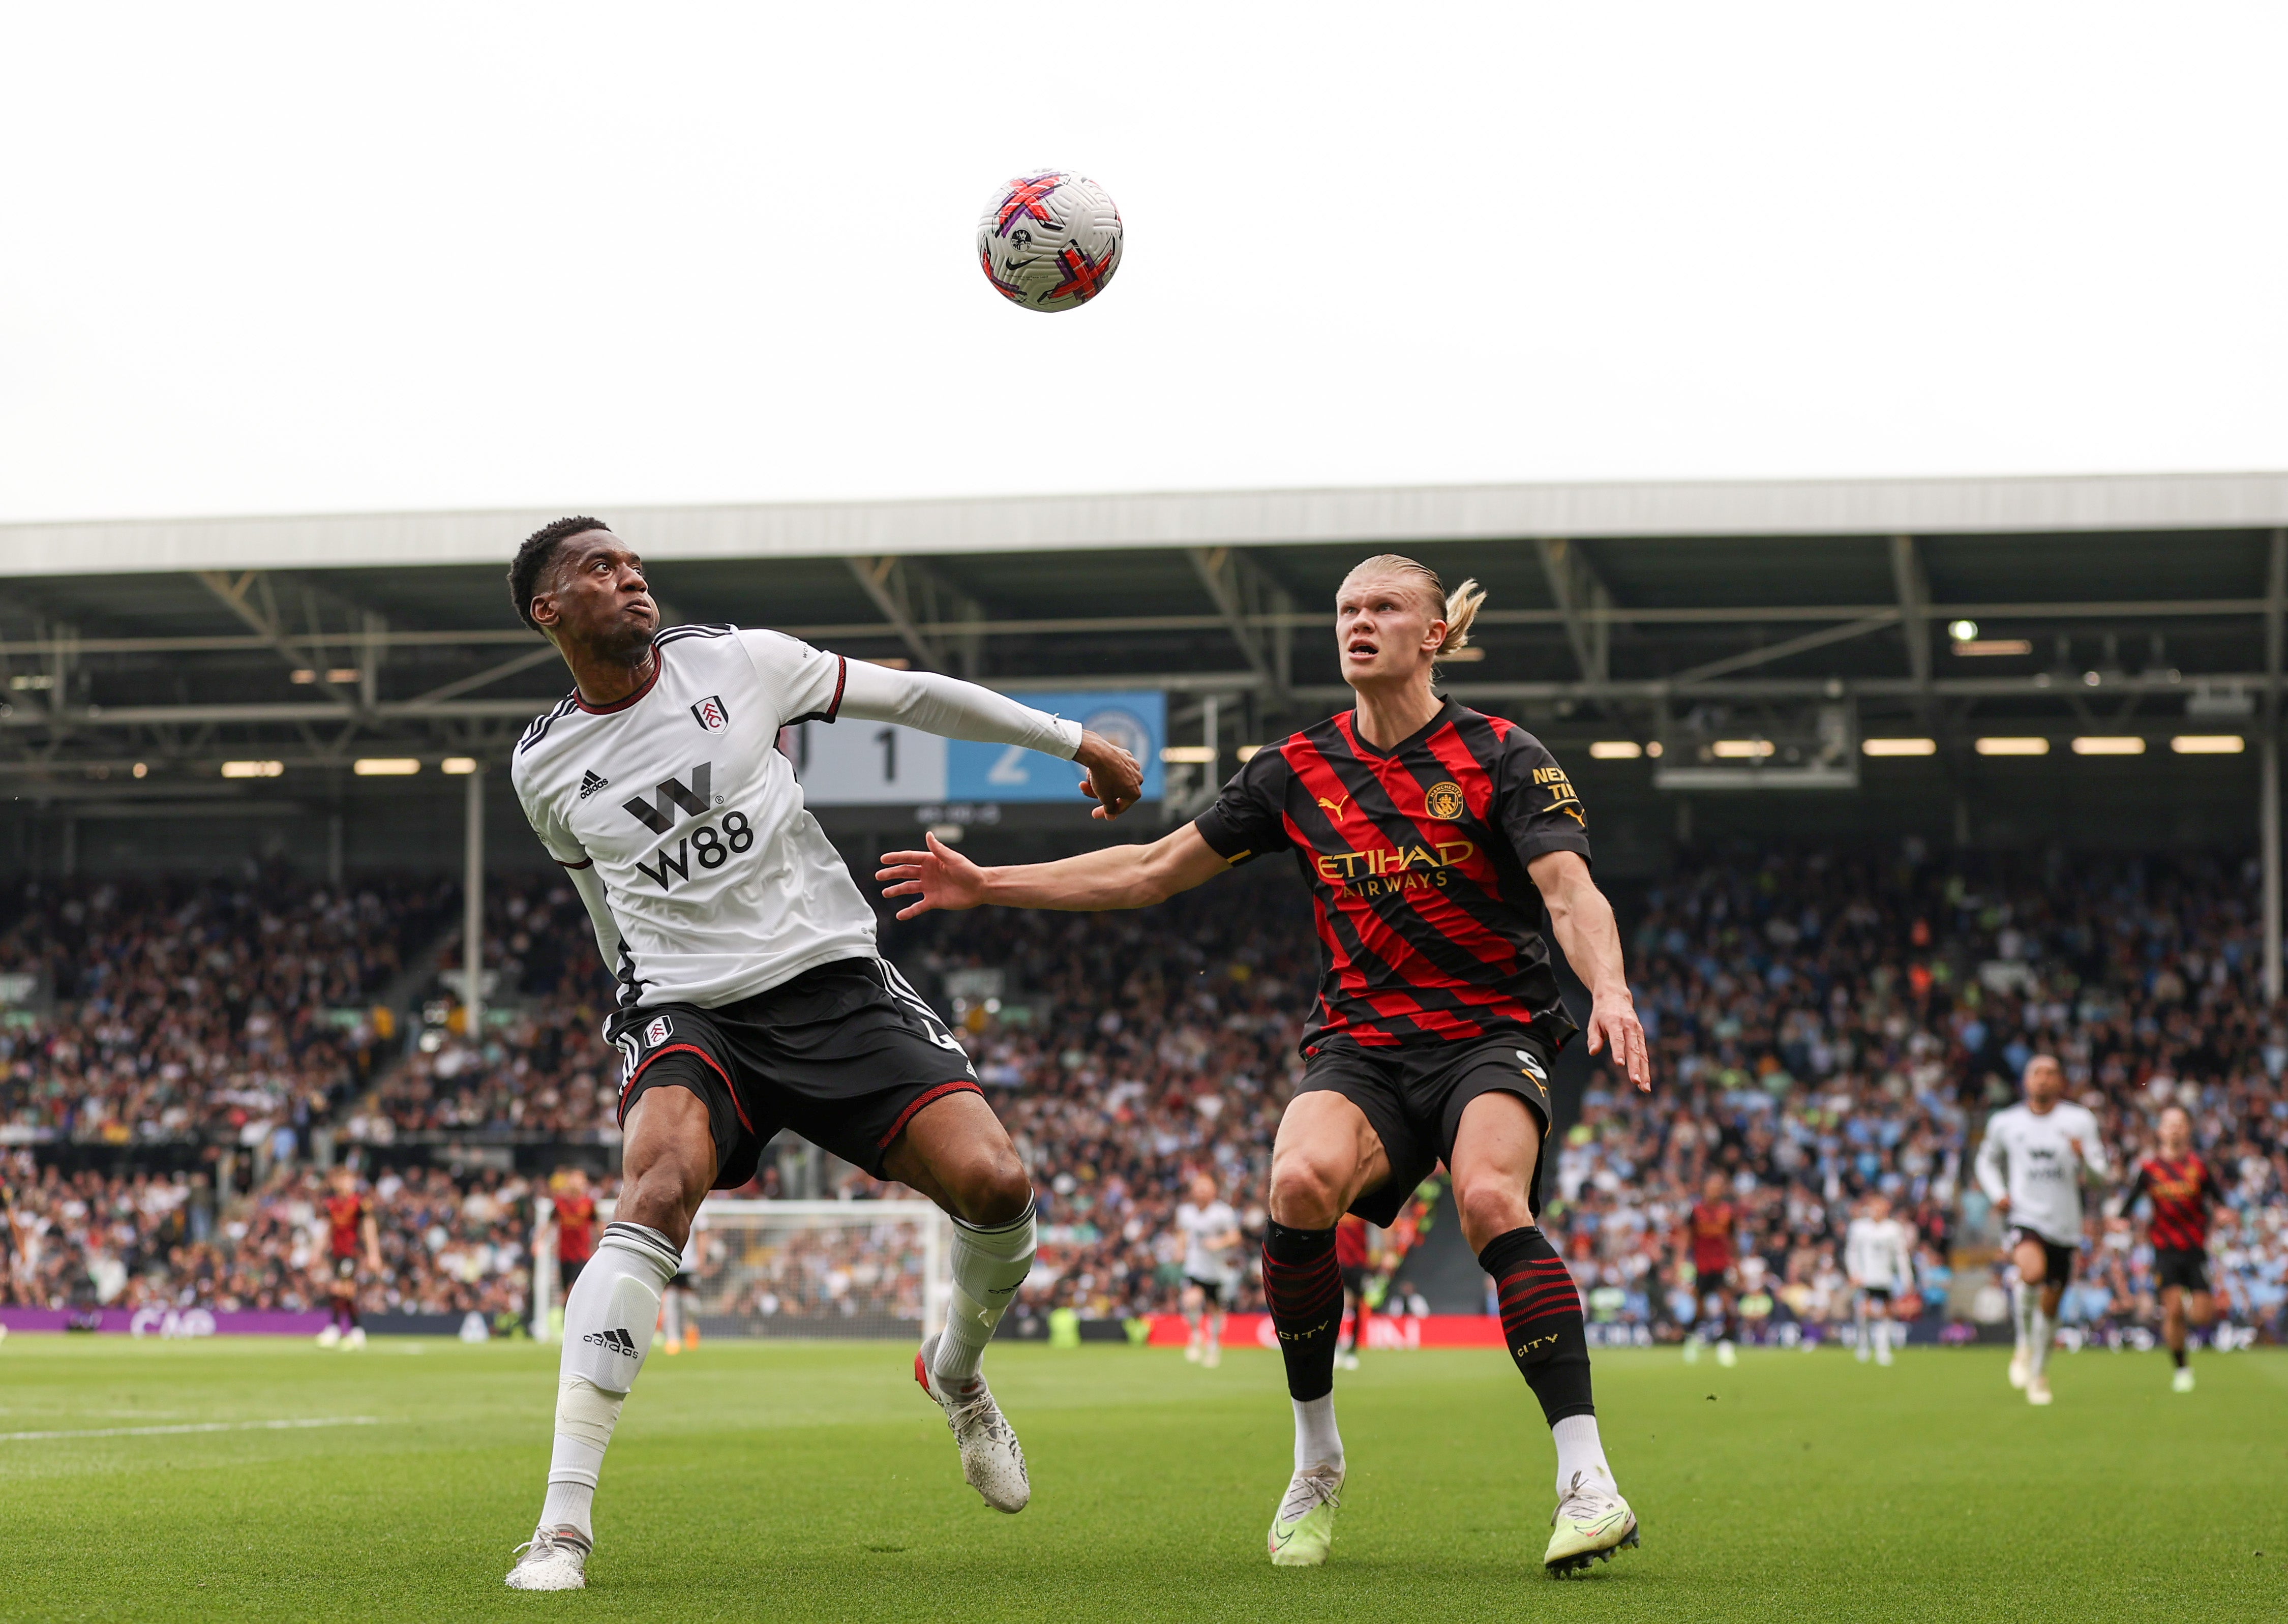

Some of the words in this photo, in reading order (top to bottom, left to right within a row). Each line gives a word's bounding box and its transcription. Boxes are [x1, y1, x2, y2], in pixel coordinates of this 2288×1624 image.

[702, 703, 722, 728] FFC
[873, 727, 896, 784] 1
[580, 778, 609, 799] adidas
[1430, 785, 1462, 798] MANCHESTER
[635, 810, 754, 892] W88
[1317, 840, 1474, 879] ETIHAD
[1342, 870, 1448, 898] AIRWAYS
[650, 1024, 665, 1043] FFC
[1279, 1320, 1329, 1341] CITY
[583, 1335, 639, 1359] adidas
[1517, 1333, 1558, 1358] CITY
